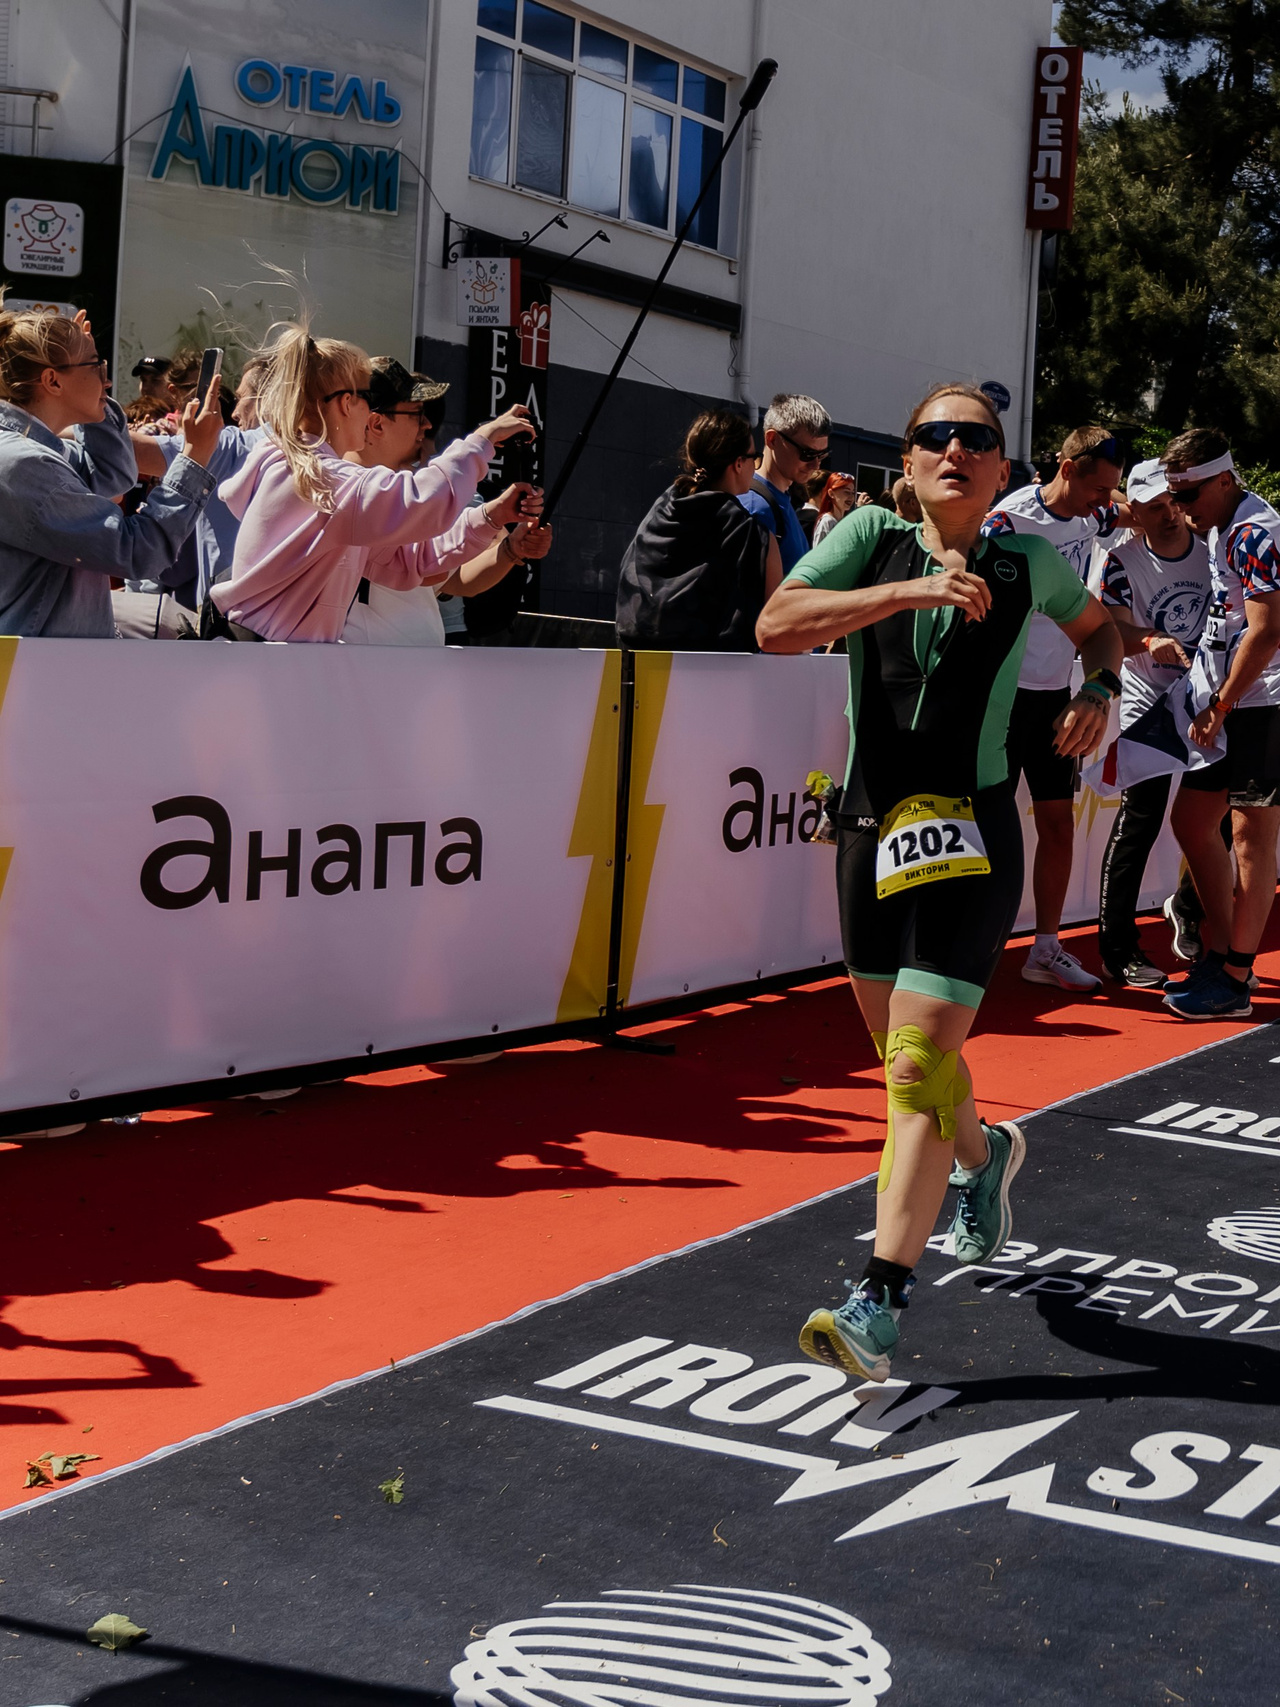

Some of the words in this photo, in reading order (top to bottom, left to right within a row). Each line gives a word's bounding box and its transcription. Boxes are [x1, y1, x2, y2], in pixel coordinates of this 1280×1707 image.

[236, 58, 402, 127] ОТЕЛЬ
[148, 56, 402, 214] АПРИОРИ
[1033, 53, 1069, 211] ОТЕЛЬ
[20, 253, 65, 264] ЮВЕЛИРНЫЕ
[21, 262, 64, 272] УКРАШЕНИЯ
[468, 305, 500, 315] ПОДАРКИ
[468, 315, 474, 324] И
[888, 823, 965, 868] 1202
[905, 862, 950, 881] ВИКТОРИЯ
[535, 1336, 962, 1449] IRON
